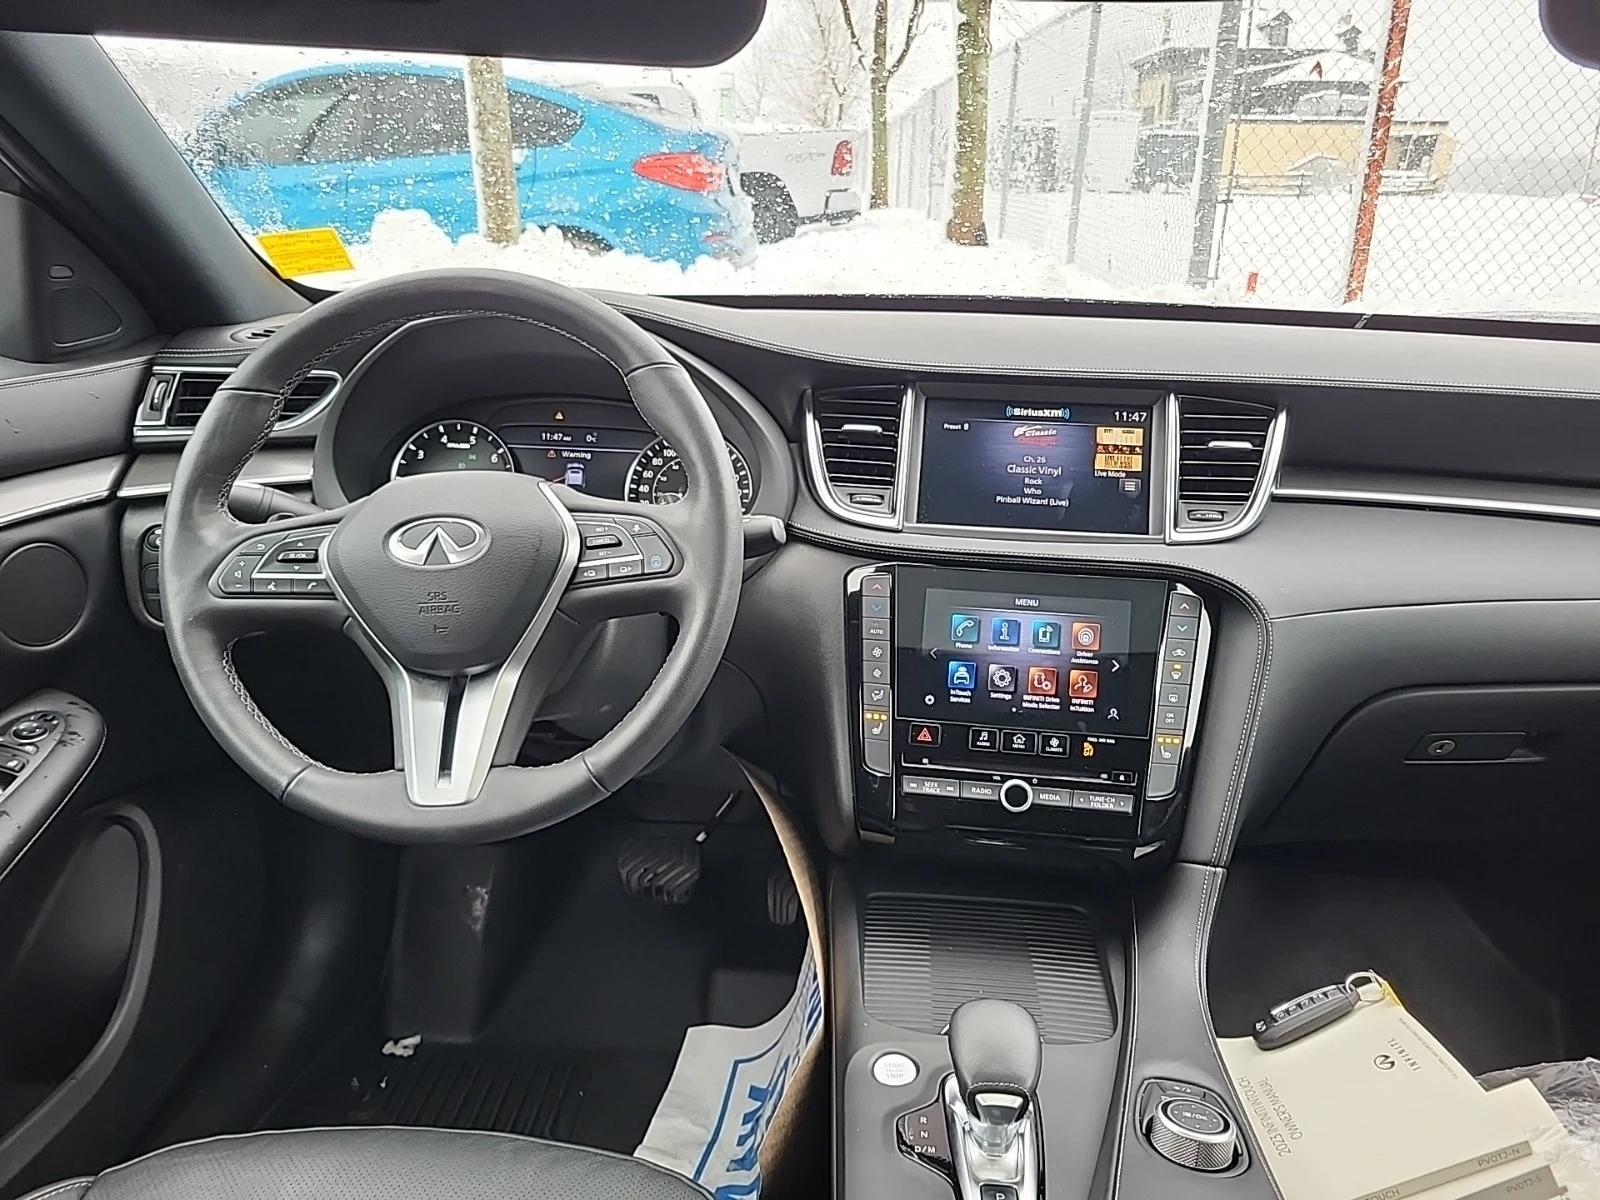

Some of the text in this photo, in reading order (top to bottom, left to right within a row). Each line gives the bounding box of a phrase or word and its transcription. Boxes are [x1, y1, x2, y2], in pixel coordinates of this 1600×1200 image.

[1114, 410, 1148, 423] 11:47
[440, 434, 449, 445] 4
[469, 435, 477, 446] 5
[416, 449, 425, 460] 3
[561, 451, 592, 460] Warning
[663, 448, 677, 457] 100
[490, 452, 499, 464] 6
[652, 458, 663, 466] 80
[1036, 456, 1047, 464] 26
[642, 470, 653, 478] 60
[1006, 463, 1062, 478] Classic Vinyl
[1094, 470, 1127, 479] Live Mode
[1024, 477, 1043, 486] Rock
[638, 484, 649, 492] 40
[1023, 487, 1043, 496] Who
[995, 495, 1070, 508] Pinball Wizard (Live)
[426, 590, 449, 602] SRS
[1014, 597, 1040, 608] MENU
[418, 604, 462, 617] AIRBAG
[955, 642, 973, 650] Phone
[987, 644, 1020, 653] Information
[1027, 647, 1062, 656] Connections
[1076, 650, 1094, 658] Driver
[989, 692, 1012, 701] Settings
[1045, 696, 1061, 704] Drive
[1022, 701, 1039, 710] Mode
[922, 786, 941, 794] TRACK
[971, 786, 992, 796] RADIO
[1039, 792, 1061, 802] MEDIA
[1089, 795, 1116, 804] TUNE-CH
[1090, 801, 1114, 810] FOLDER
[1258, 1076, 1282, 1108] MANUAL
[920, 1116, 928, 1124] R
[920, 1130, 929, 1139] N
[1269, 1132, 1292, 1157] 2023
[914, 1145, 936, 1154] D/M
[995, 1192, 1006, 1200] P
